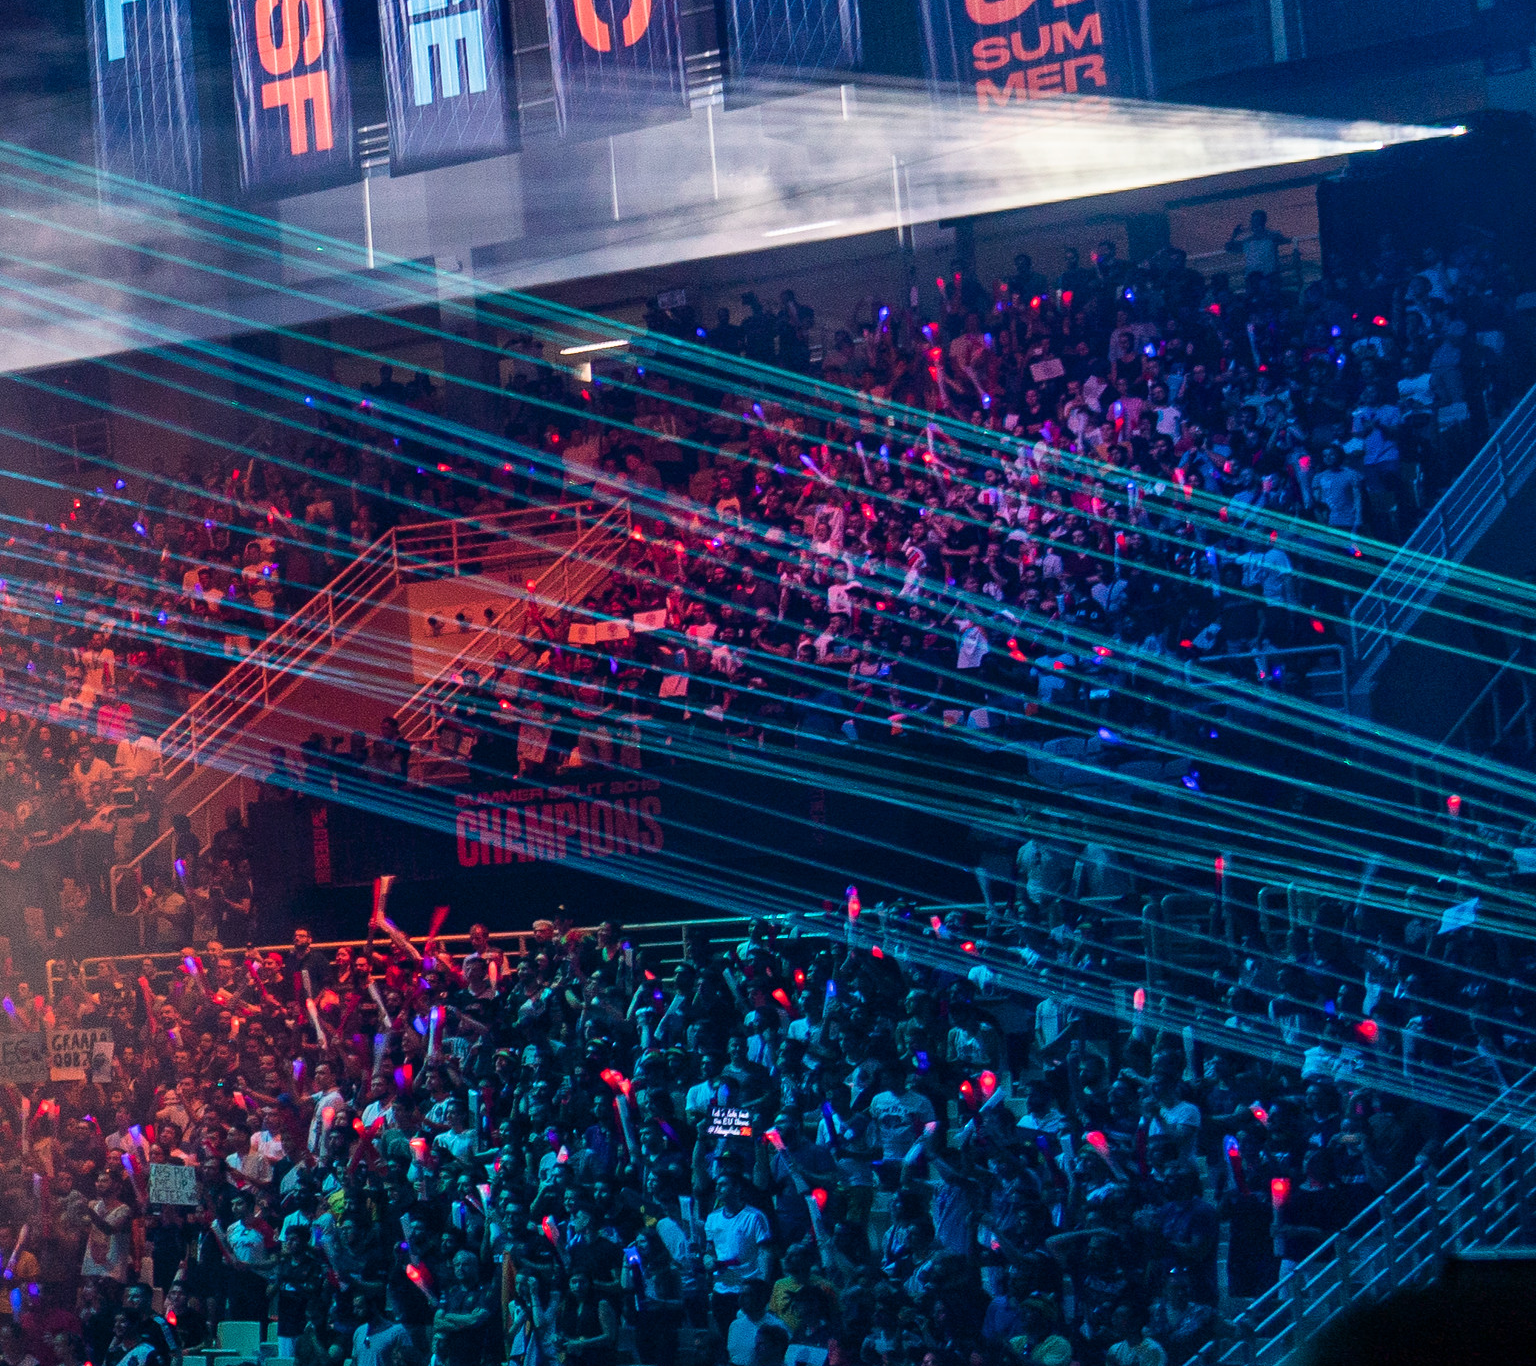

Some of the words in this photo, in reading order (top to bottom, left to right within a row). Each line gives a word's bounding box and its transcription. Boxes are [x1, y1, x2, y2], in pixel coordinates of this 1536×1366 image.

[971, 12, 1103, 71] SUM
[975, 53, 1107, 113] MER
[455, 795, 665, 868] CHAMPIONS
